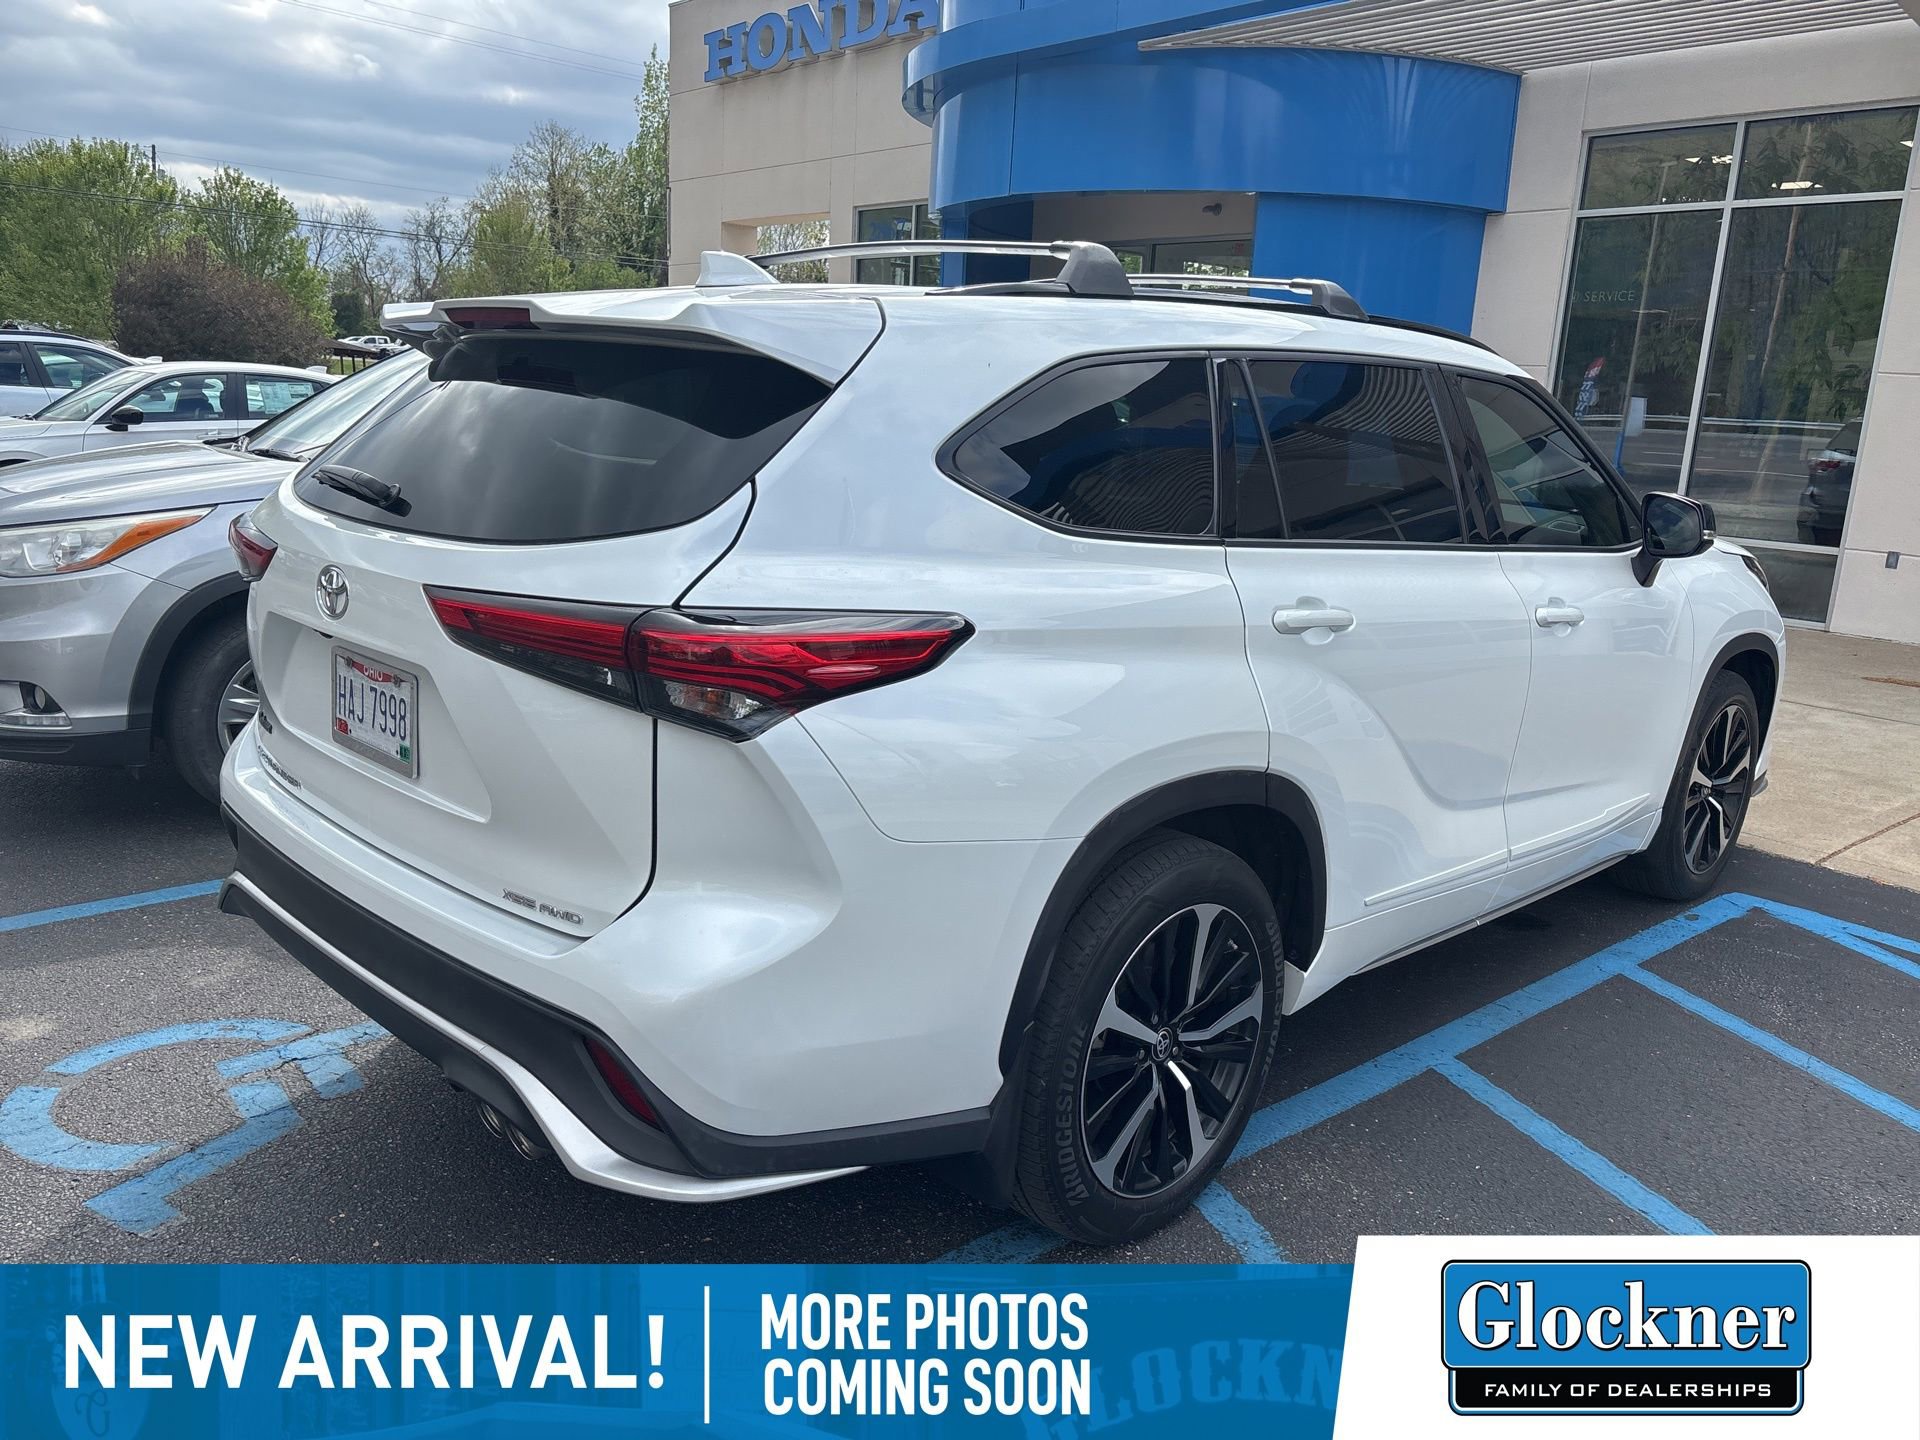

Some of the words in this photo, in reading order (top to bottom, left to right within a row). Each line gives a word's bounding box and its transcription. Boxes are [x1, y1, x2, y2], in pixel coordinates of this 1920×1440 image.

[703, 0, 939, 83] HONDA
[1583, 290, 1635, 303] SERVICE
[363, 665, 384, 681] OHIO
[338, 674, 365, 724] HAJ
[370, 685, 407, 742] 7998
[502, 887, 538, 911] XSE
[539, 903, 584, 926] AWD
